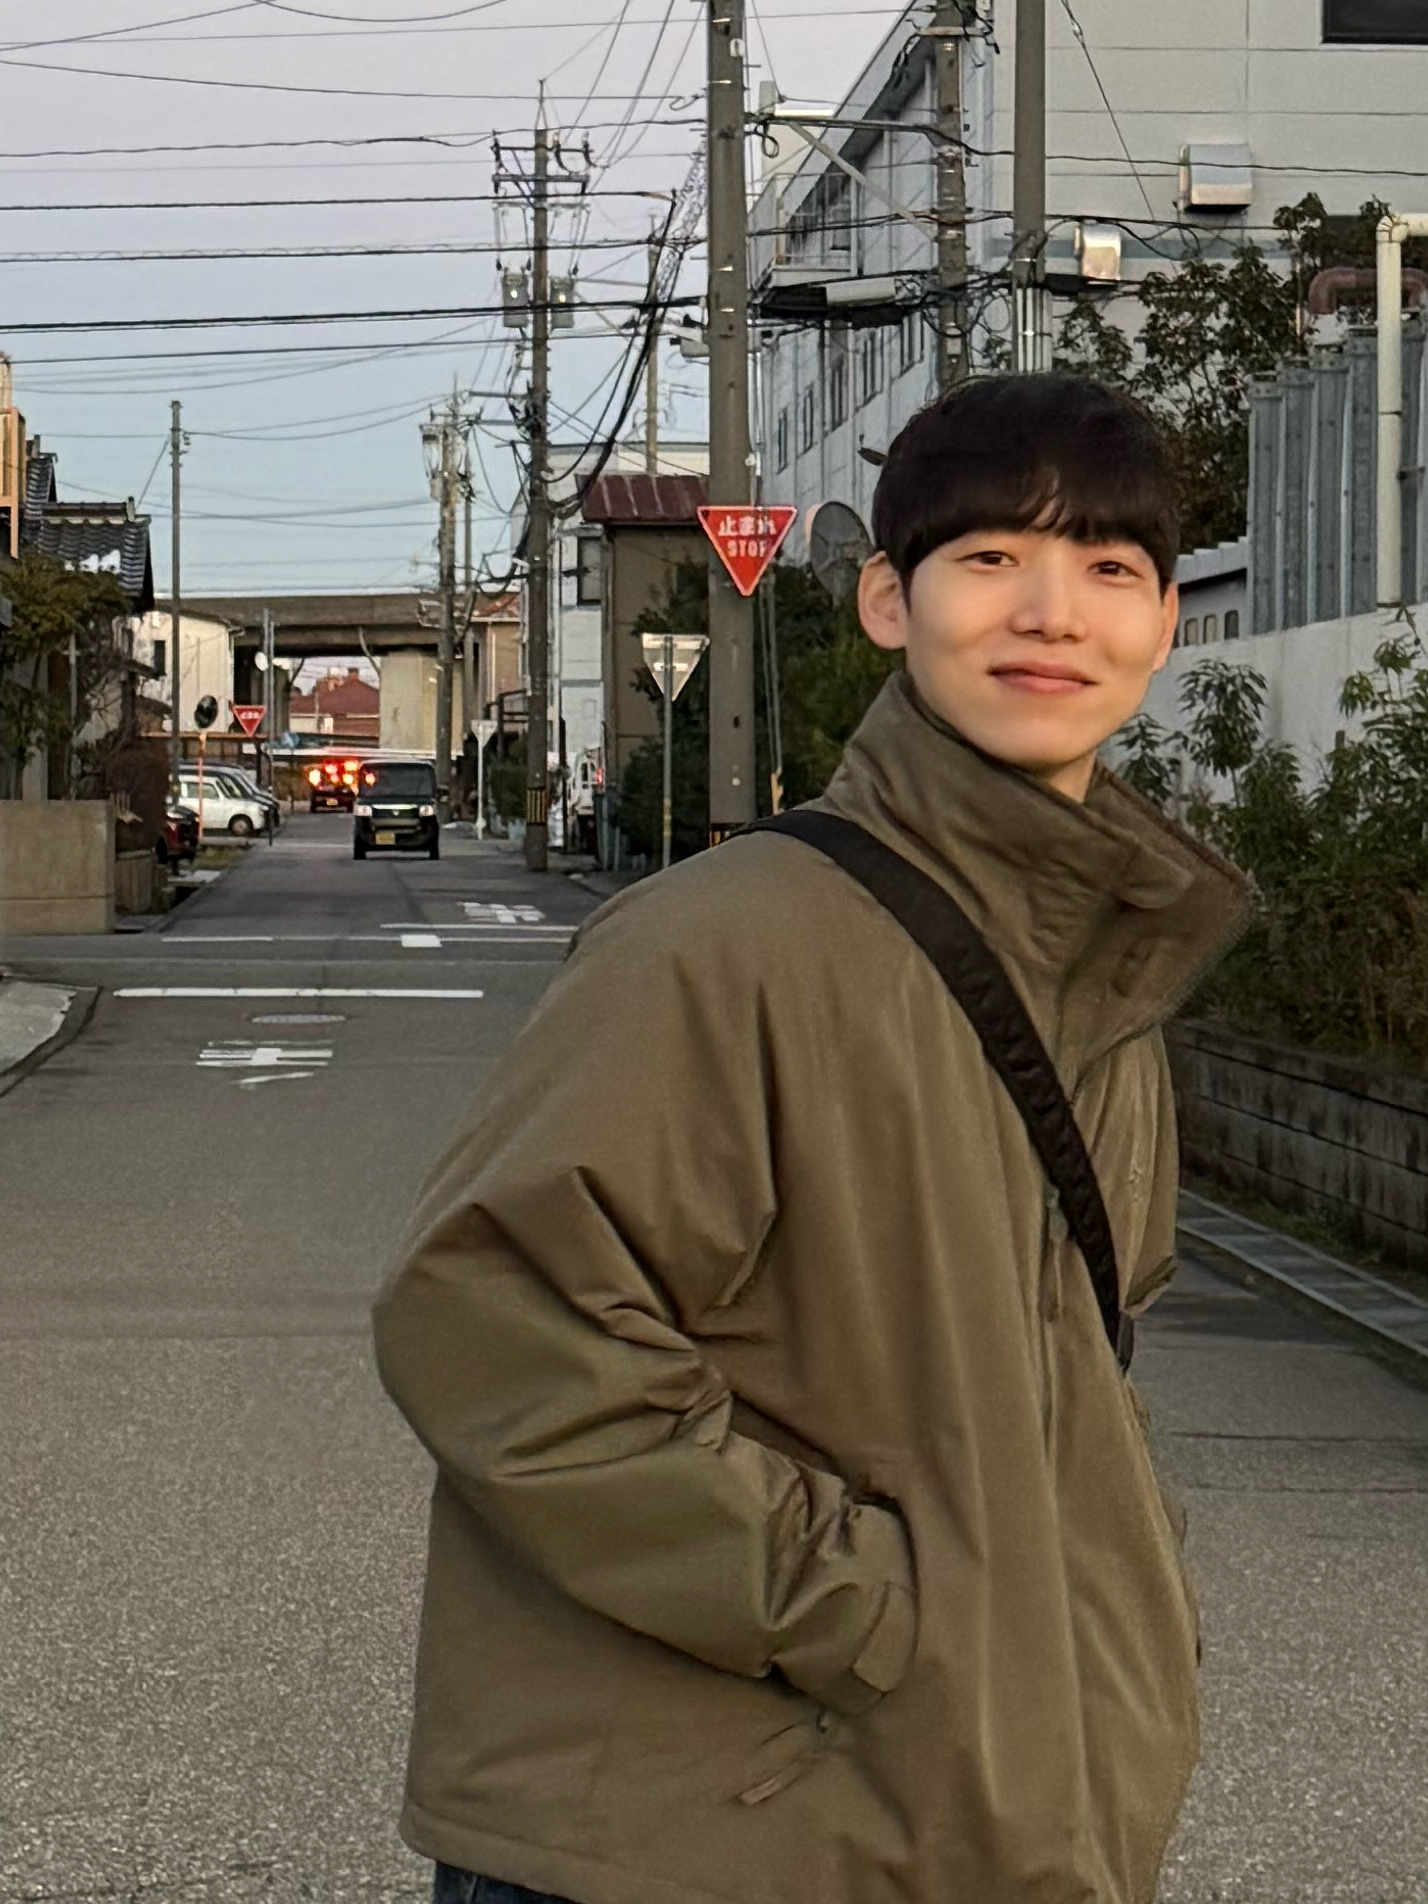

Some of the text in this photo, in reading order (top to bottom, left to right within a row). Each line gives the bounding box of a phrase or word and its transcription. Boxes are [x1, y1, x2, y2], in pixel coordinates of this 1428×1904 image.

[718, 515, 776, 536] 止まれ
[726, 540, 767, 558] STOP
